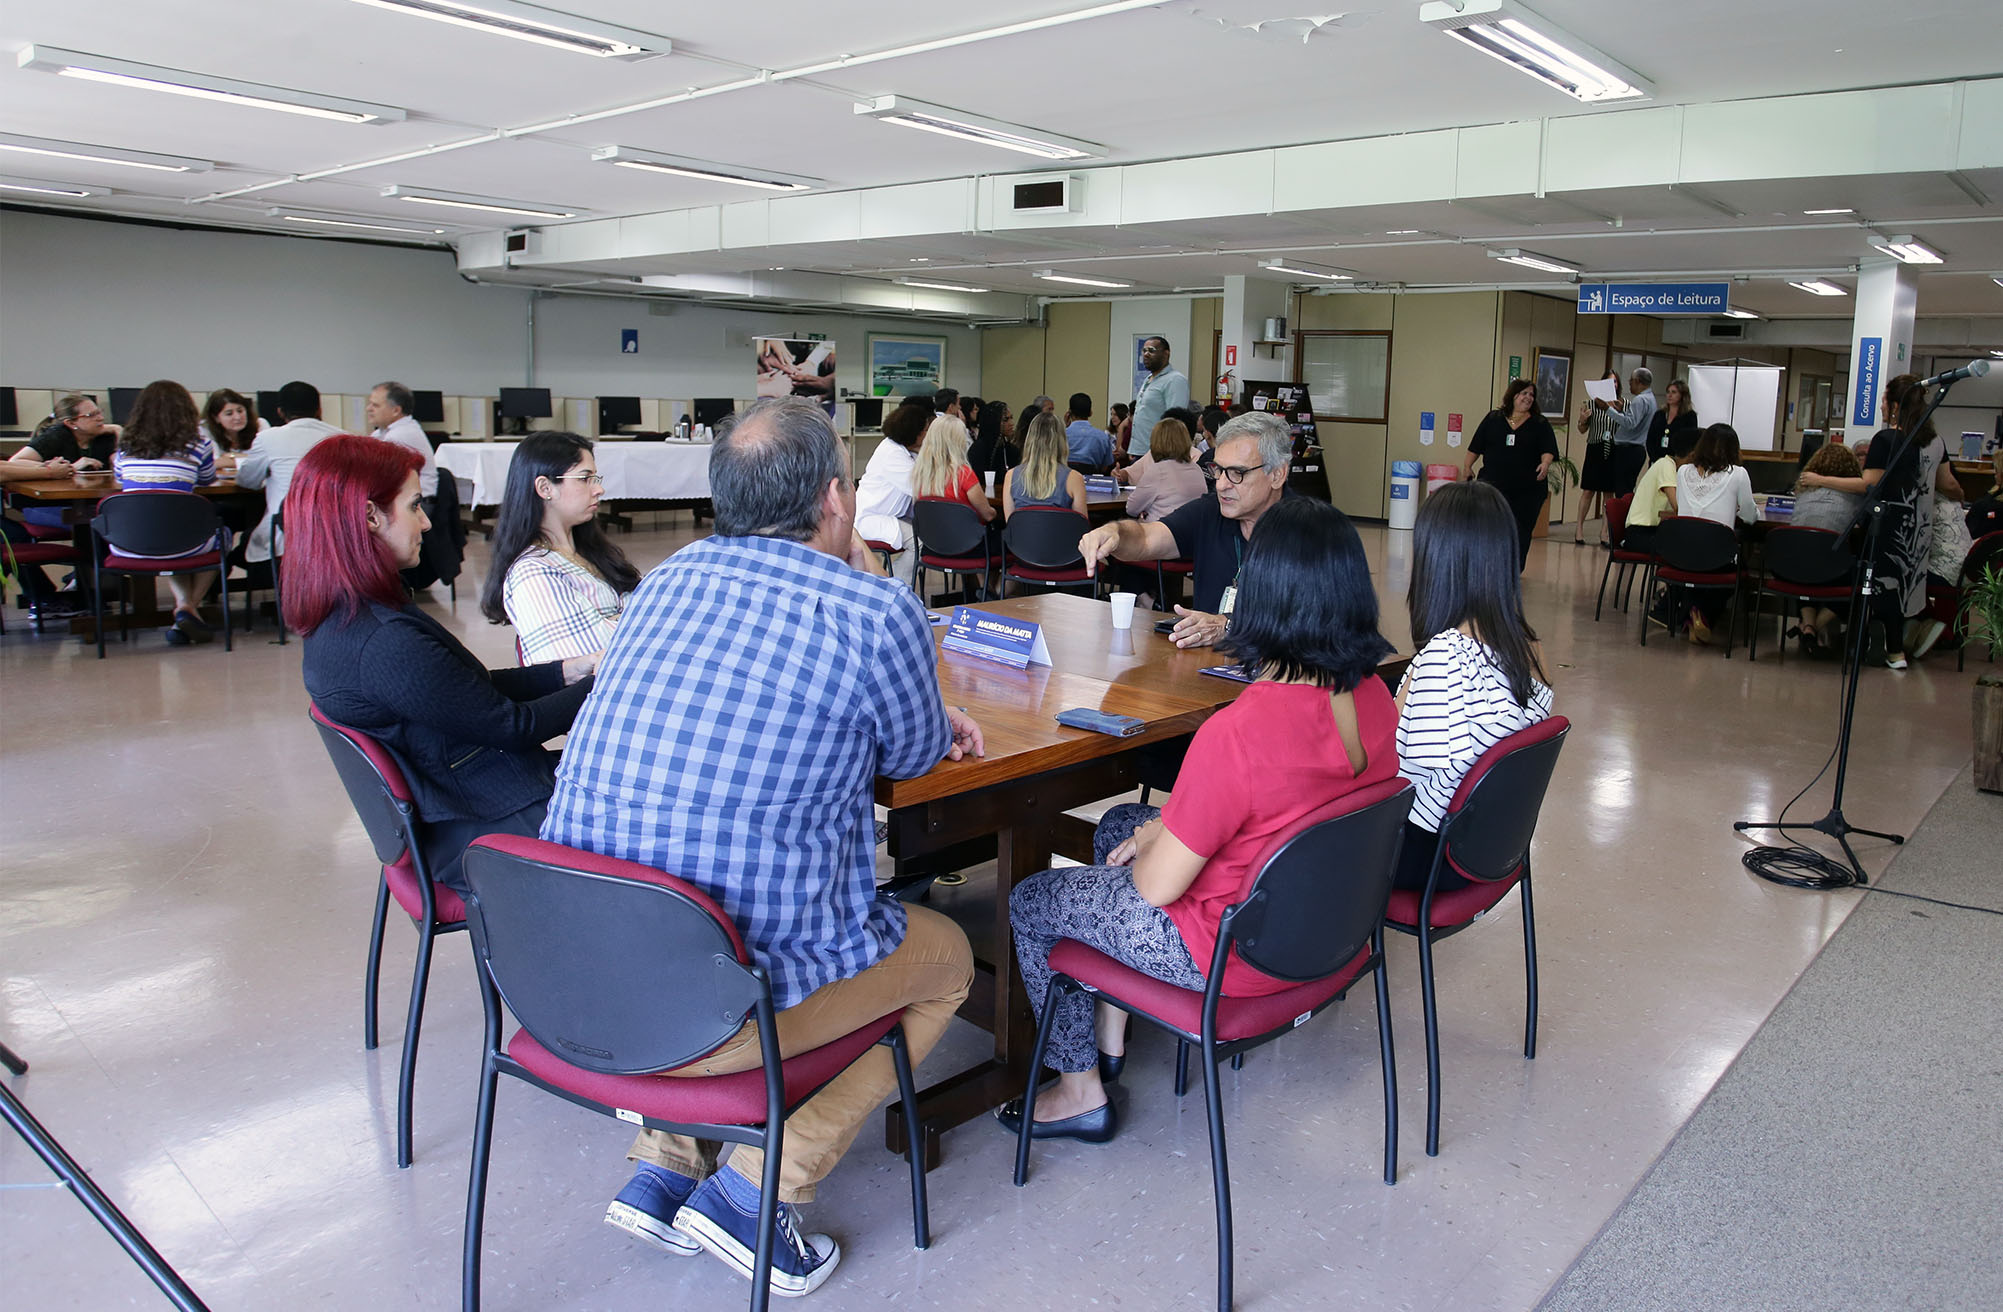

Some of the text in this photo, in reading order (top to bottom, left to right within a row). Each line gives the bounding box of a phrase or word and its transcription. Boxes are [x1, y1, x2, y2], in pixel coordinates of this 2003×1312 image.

[1612, 292, 1721, 308] Espaço de Leitura
[1860, 344, 1875, 419] Consulta ao Acervo
